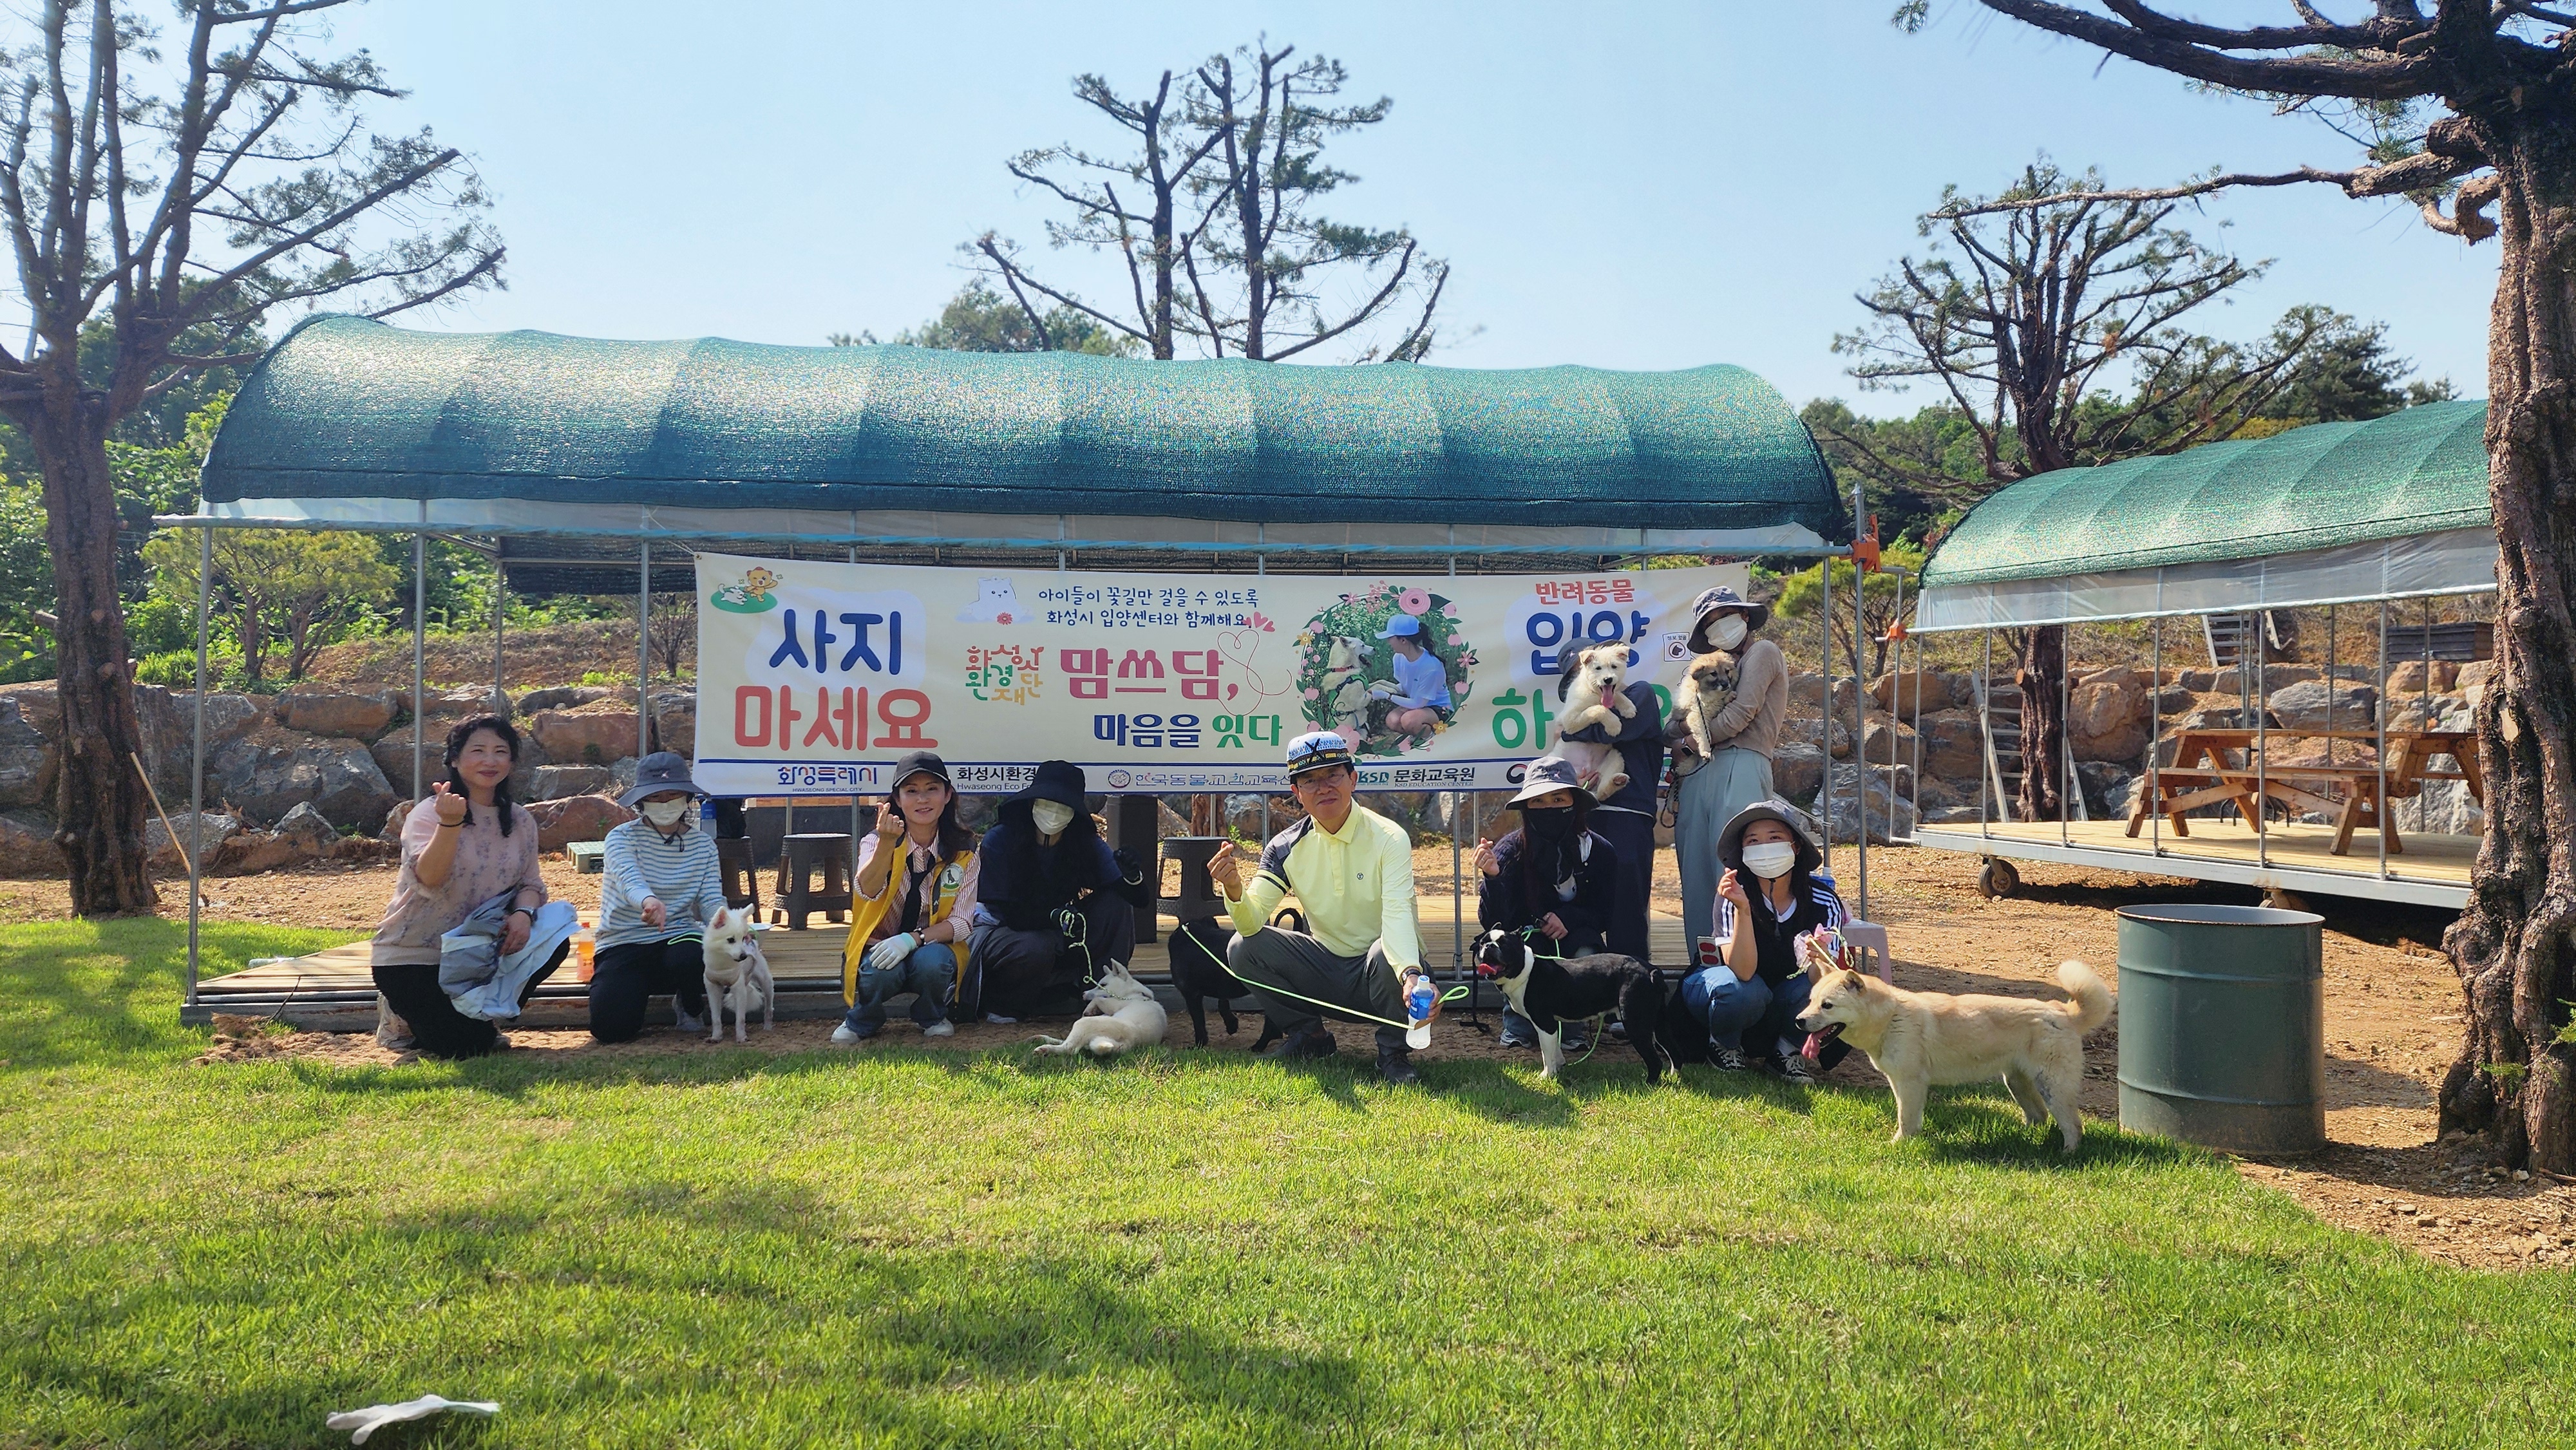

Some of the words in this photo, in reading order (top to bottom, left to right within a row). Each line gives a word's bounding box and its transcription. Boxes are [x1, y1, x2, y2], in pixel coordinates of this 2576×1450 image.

[1038, 586, 1099, 605] 아이들이
[1106, 587, 1153, 607] 꽃길만
[1159, 587, 1188, 607] 걸을
[1195, 590, 1209, 605] 수
[1215, 588, 1260, 608] 있도록
[1535, 578, 1636, 606] 반려동물
[1046, 609, 1094, 626] 화성시
[1100, 608, 1179, 628] 입양센터와
[769, 608, 902, 675] 사지
[1526, 610, 1651, 676] 입양
[1060, 648, 1239, 701] 맘쓰담,
[734, 684, 938, 751] 마세요
[1094, 713, 1202, 748] 마음을
[1212, 714, 1283, 749] 잇다
[777, 766, 877, 786] 화성특례시
[957, 766, 1037, 781] 화성시환경
[1357, 770, 1390, 783] KSD
[1394, 767, 1475, 782] 문화교육원
[957, 783, 1002, 791] Hwaseong
